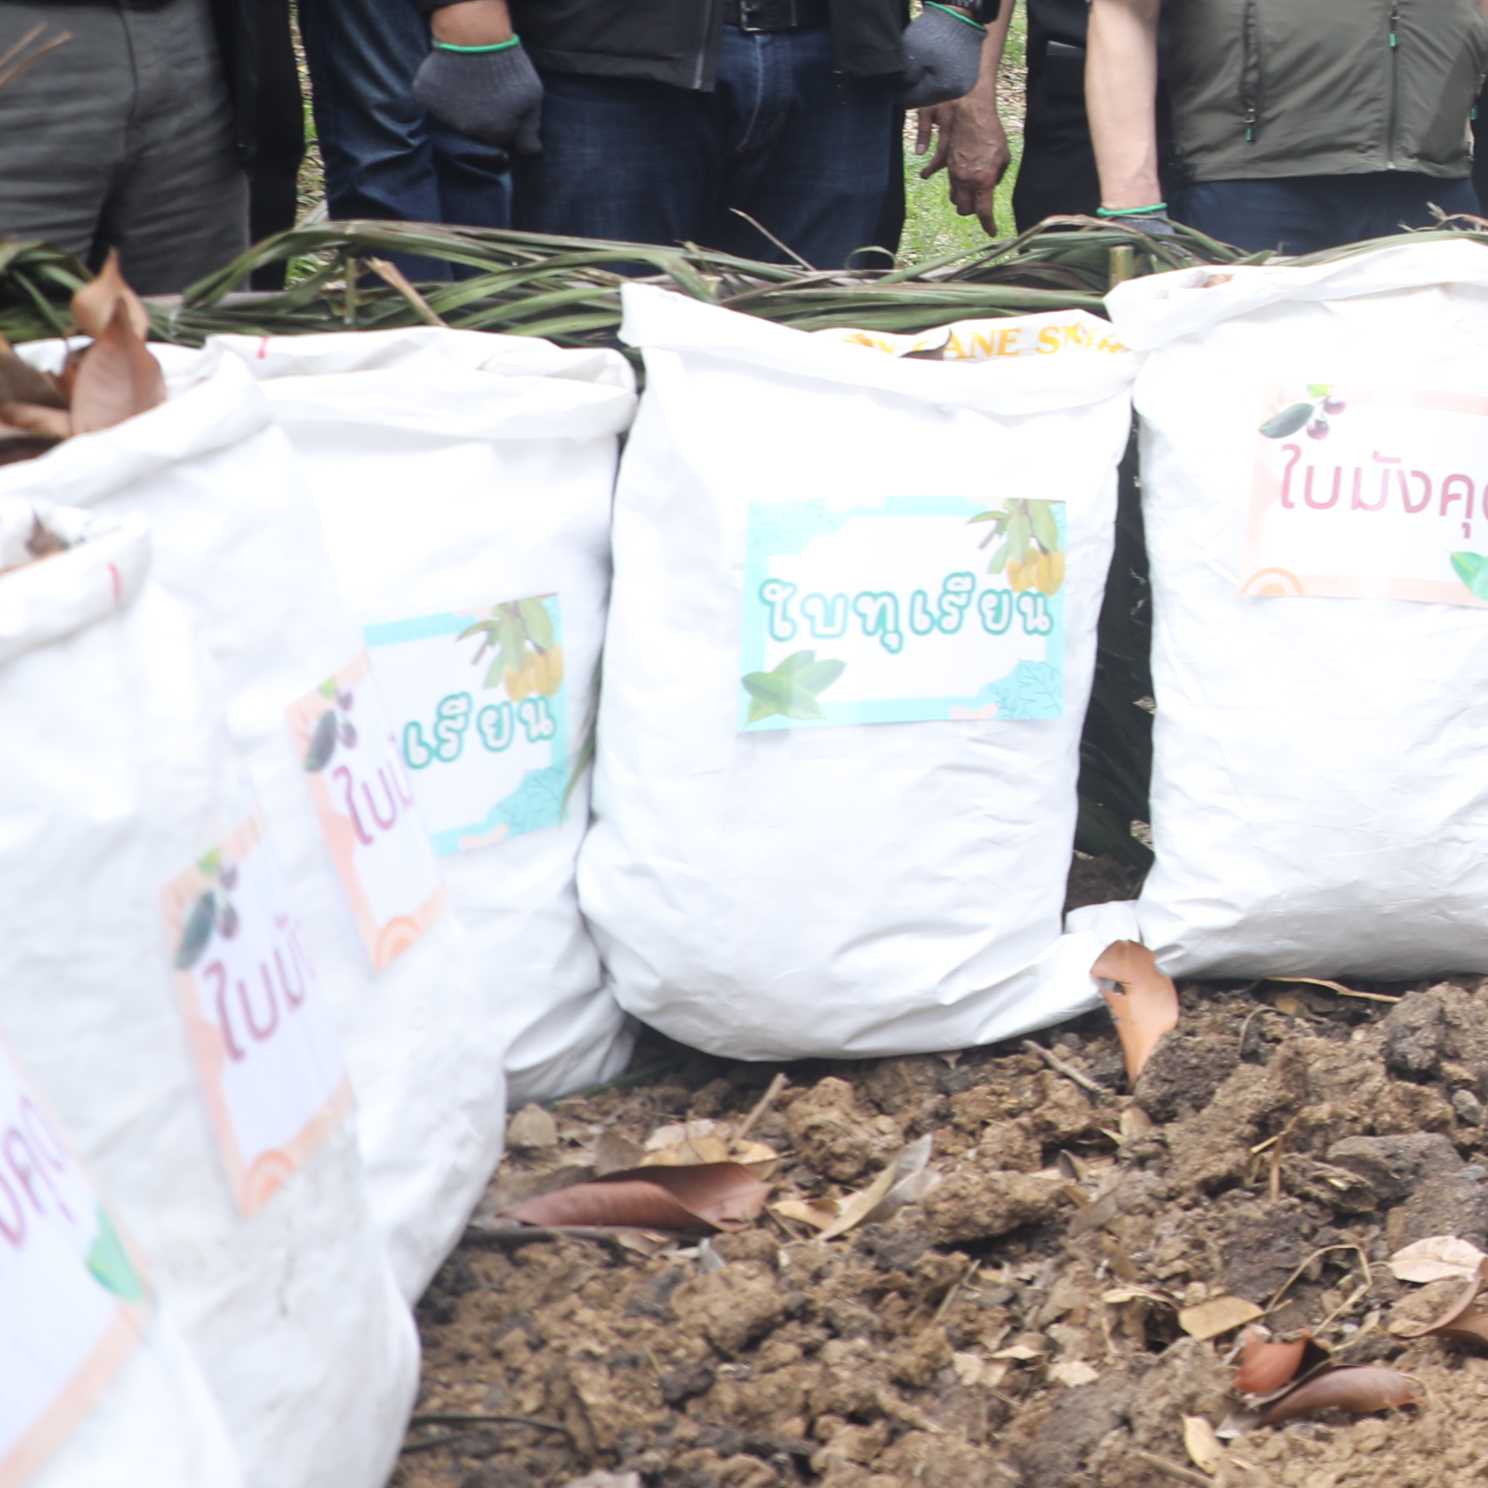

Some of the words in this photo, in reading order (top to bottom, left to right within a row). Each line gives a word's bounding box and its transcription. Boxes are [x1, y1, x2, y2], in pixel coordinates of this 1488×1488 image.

[914, 328, 1022, 360] ANE
[758, 570, 1054, 653] ใบทุเรียน
[402, 692, 557, 770] เรียน
